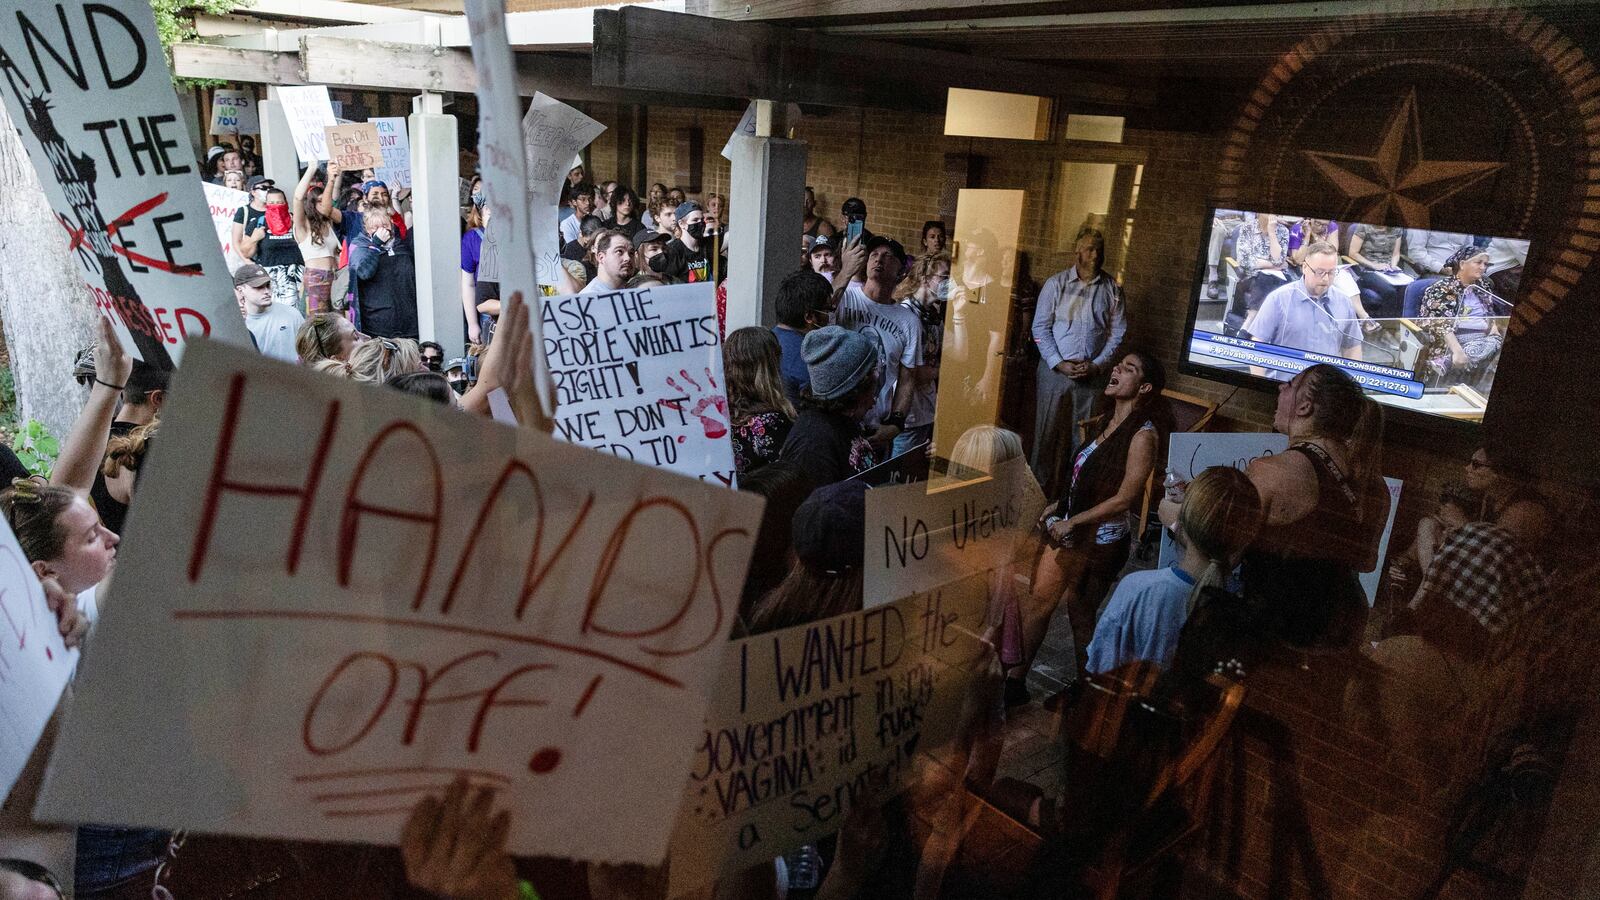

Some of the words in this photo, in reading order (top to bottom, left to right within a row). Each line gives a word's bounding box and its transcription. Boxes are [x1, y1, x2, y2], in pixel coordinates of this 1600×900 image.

[220, 106, 238, 116] NO
[234, 97, 249, 107] IS
[216, 116, 238, 126] YOU
[83, 114, 191, 178] THE
[379, 135, 398, 146] ONT
[395, 147, 407, 158] TO
[42, 140, 80, 181] MY
[394, 169, 411, 184] ME
[60, 180, 95, 207] BODY
[208, 206, 237, 218] OMA
[57, 211, 204, 276] REE
[86, 283, 211, 343] PPRESSED
[542, 296, 600, 335] ASK
[598, 288, 660, 326] THE
[543, 326, 624, 369] PEOPLE
[623, 320, 684, 359] WHAT
[685, 315, 718, 349] IS
[1210, 335, 1227, 343] JUNE
[1218, 347, 1246, 361] Private
[1248, 353, 1304, 371] Reproductive
[1304, 353, 1346, 366] INDIVIDUAL
[1347, 361, 1412, 379] CONSIDERATION
[550, 360, 644, 406] RIGHT!
[1367, 376, 1410, 394] 22-1275)
[554, 411, 606, 443] WE
[639, 434, 678, 466] TO
[186, 371, 750, 657] HANDS
[884, 516, 929, 569] NO
[740, 642, 747, 714] I
[774, 605, 906, 702] WANTED
[920, 590, 960, 653] the
[302, 649, 606, 775] OFF!
[714, 750, 814, 817] VAGINA
[739, 823, 762, 850] a
